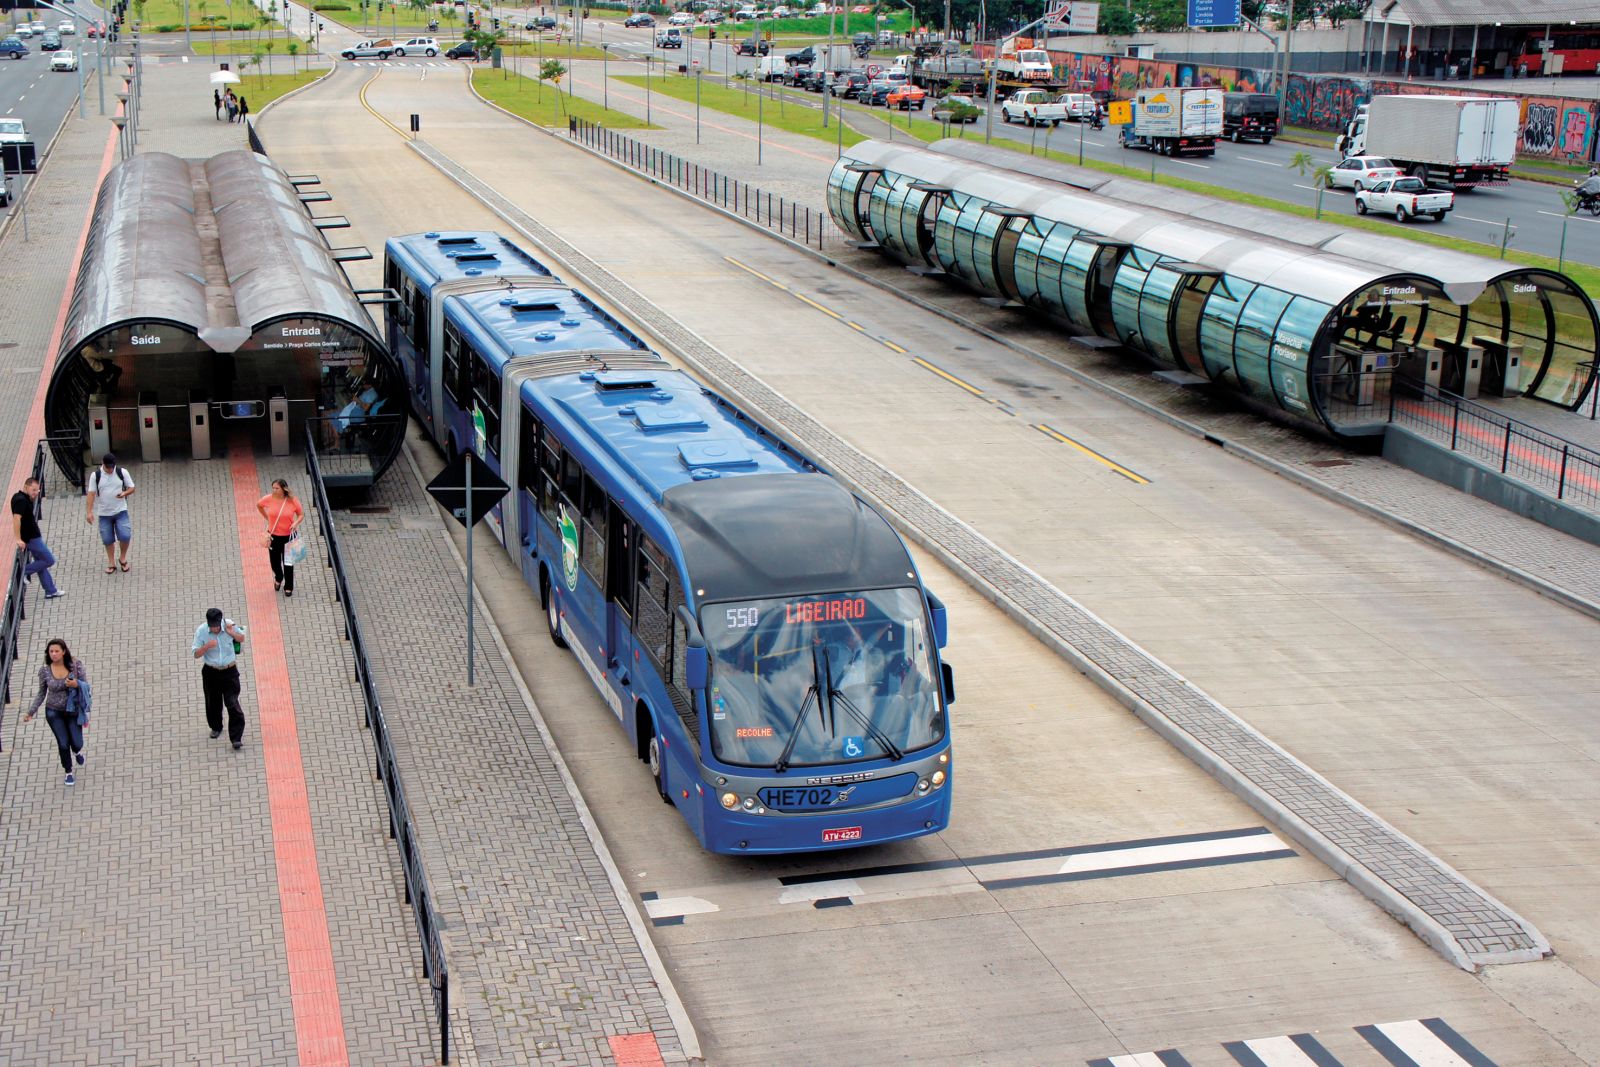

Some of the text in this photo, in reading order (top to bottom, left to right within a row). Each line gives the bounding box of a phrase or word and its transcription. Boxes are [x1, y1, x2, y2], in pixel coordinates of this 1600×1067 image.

[1383, 286, 1416, 295] Entrada
[1513, 284, 1537, 293] Saída
[282, 326, 321, 337] Entrada
[131, 335, 161, 345] Saída
[1273, 344, 1297, 361] Floriano
[726, 607, 759, 629] 550
[736, 728, 772, 737] RECOLHE
[767, 788, 832, 806] HE702
